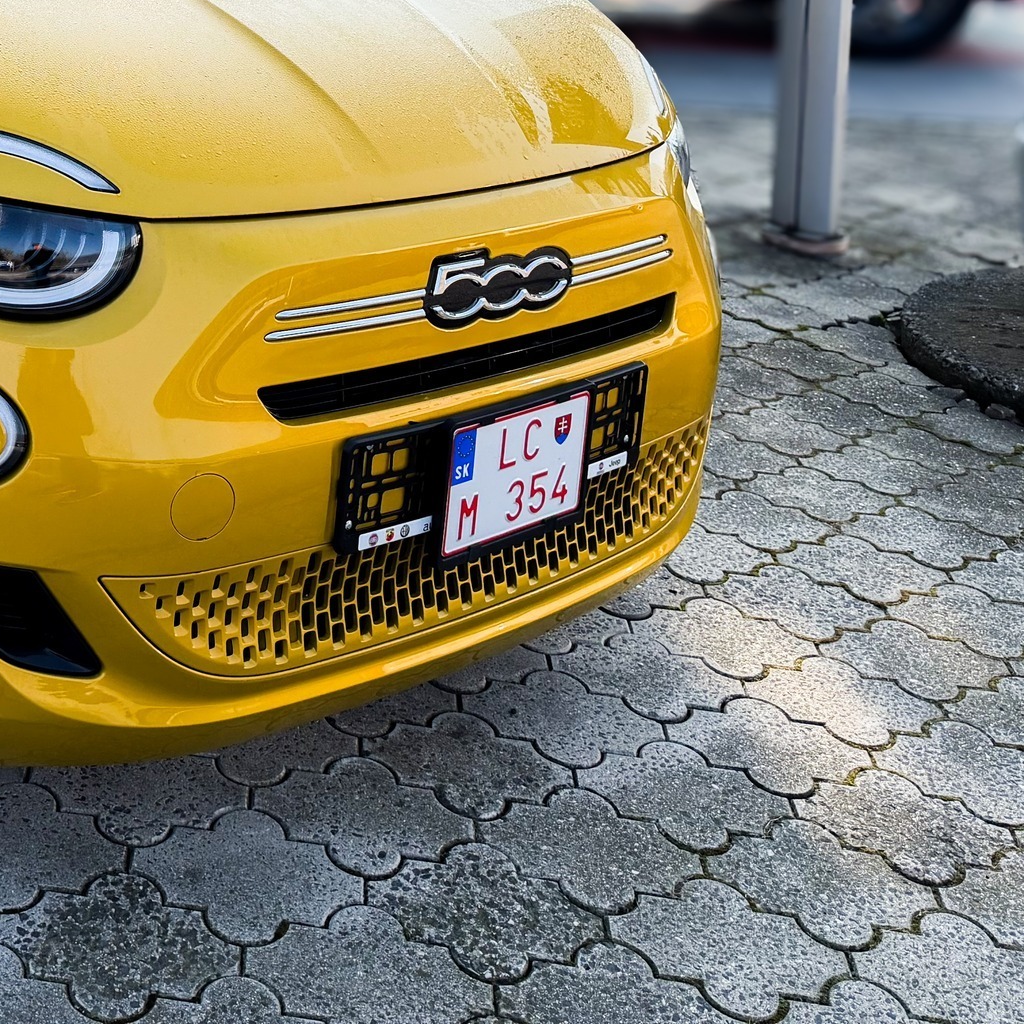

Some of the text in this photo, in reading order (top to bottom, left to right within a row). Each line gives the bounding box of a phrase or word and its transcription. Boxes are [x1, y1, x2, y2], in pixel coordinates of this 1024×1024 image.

[431, 251, 570, 324] 500
[455, 463, 470, 480] SK
[498, 418, 542, 470] LC
[457, 464, 568, 541] M 354
